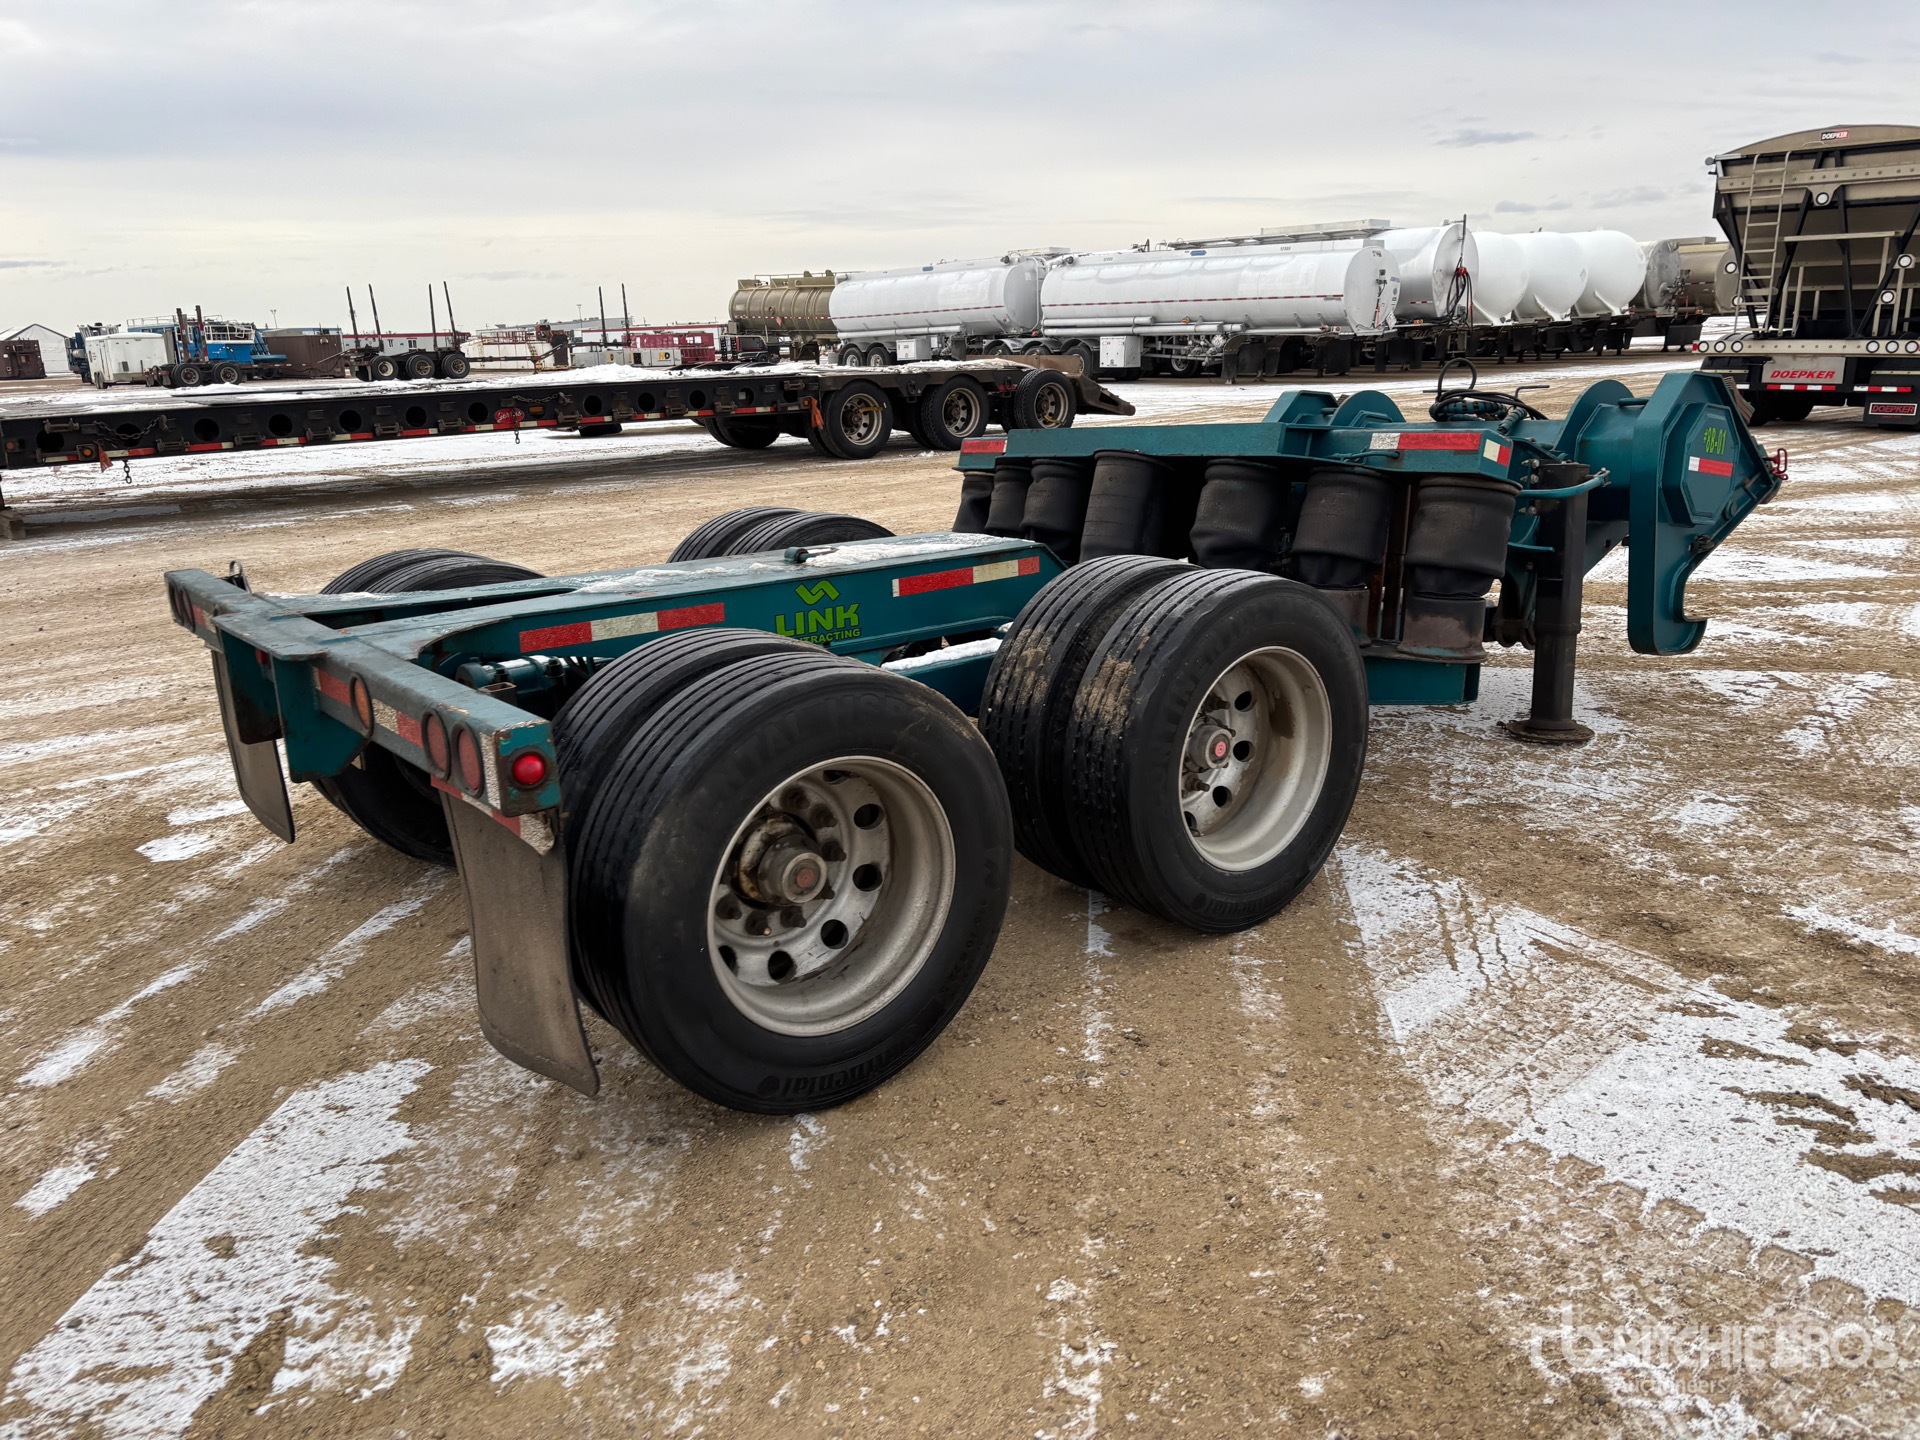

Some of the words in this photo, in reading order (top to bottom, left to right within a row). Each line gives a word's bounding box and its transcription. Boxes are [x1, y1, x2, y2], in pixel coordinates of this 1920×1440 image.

[1770, 370, 1836, 379] DOEPKER
[1871, 405, 1915, 413] DOEPKER
[775, 603, 860, 637] LINK
[798, 628, 861, 644] TRACTING
